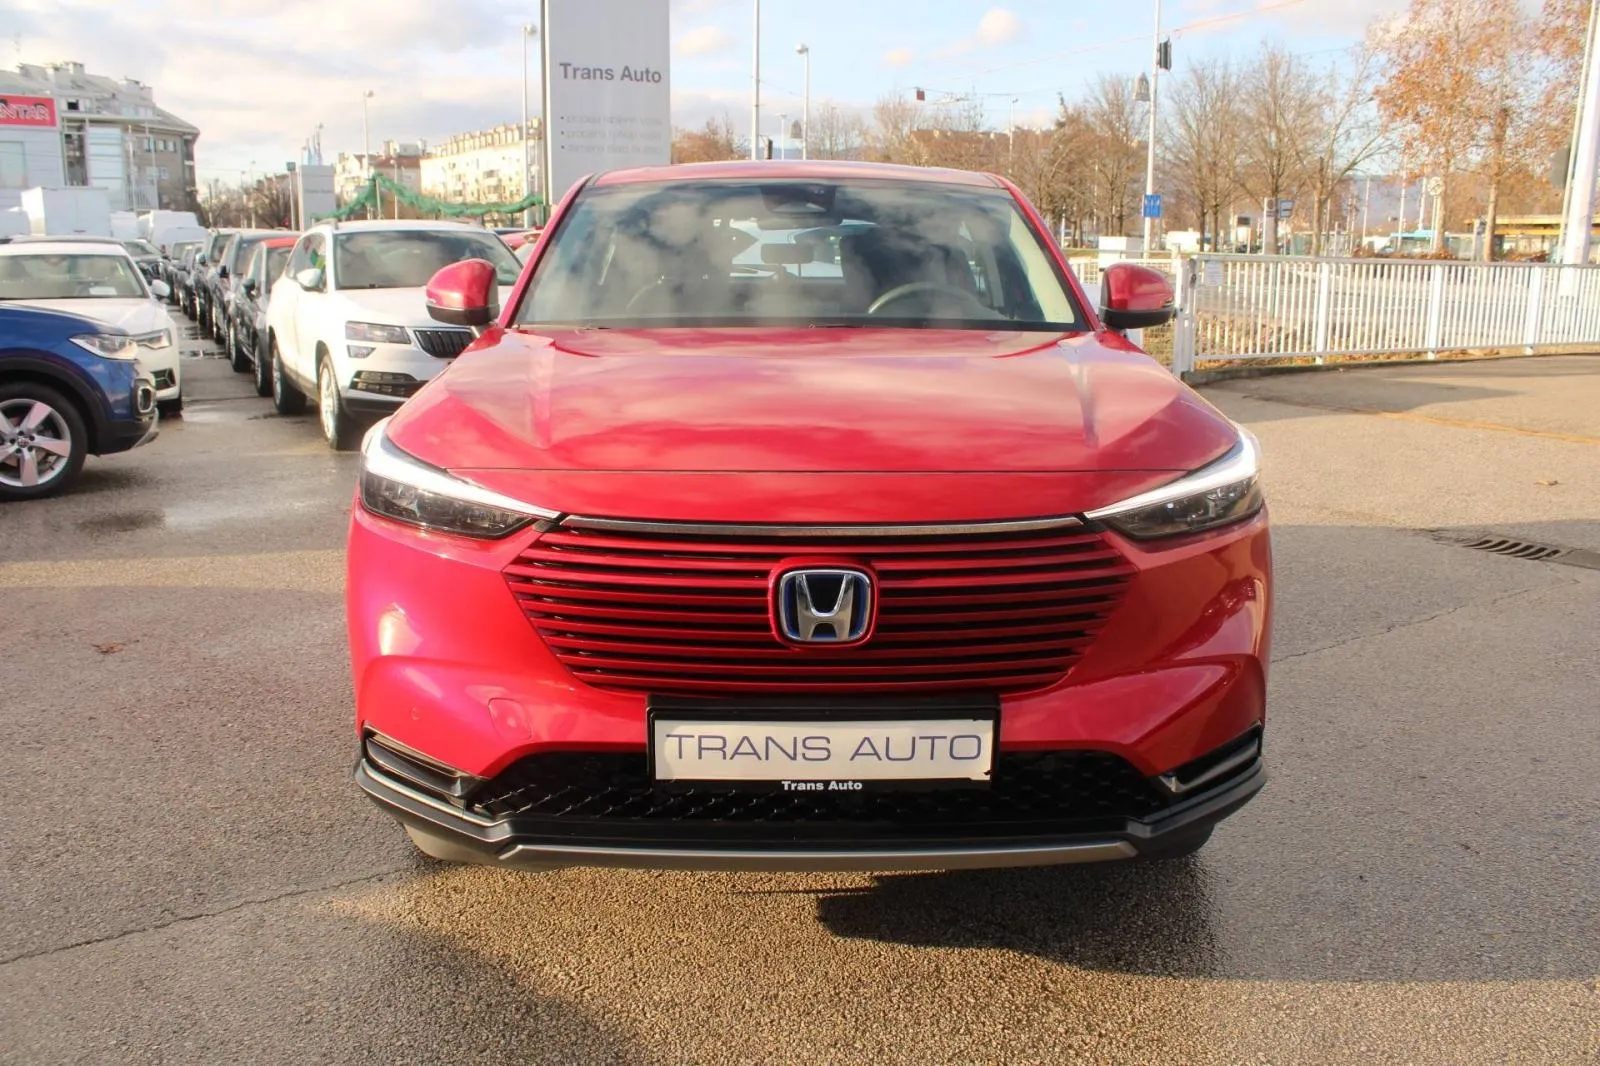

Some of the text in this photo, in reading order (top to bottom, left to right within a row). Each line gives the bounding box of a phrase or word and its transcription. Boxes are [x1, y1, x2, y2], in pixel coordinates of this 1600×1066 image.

[558, 62, 662, 83] Trans Auto
[665, 733, 982, 762] TRANS AUTO
[781, 780, 863, 791] Trans Auto
